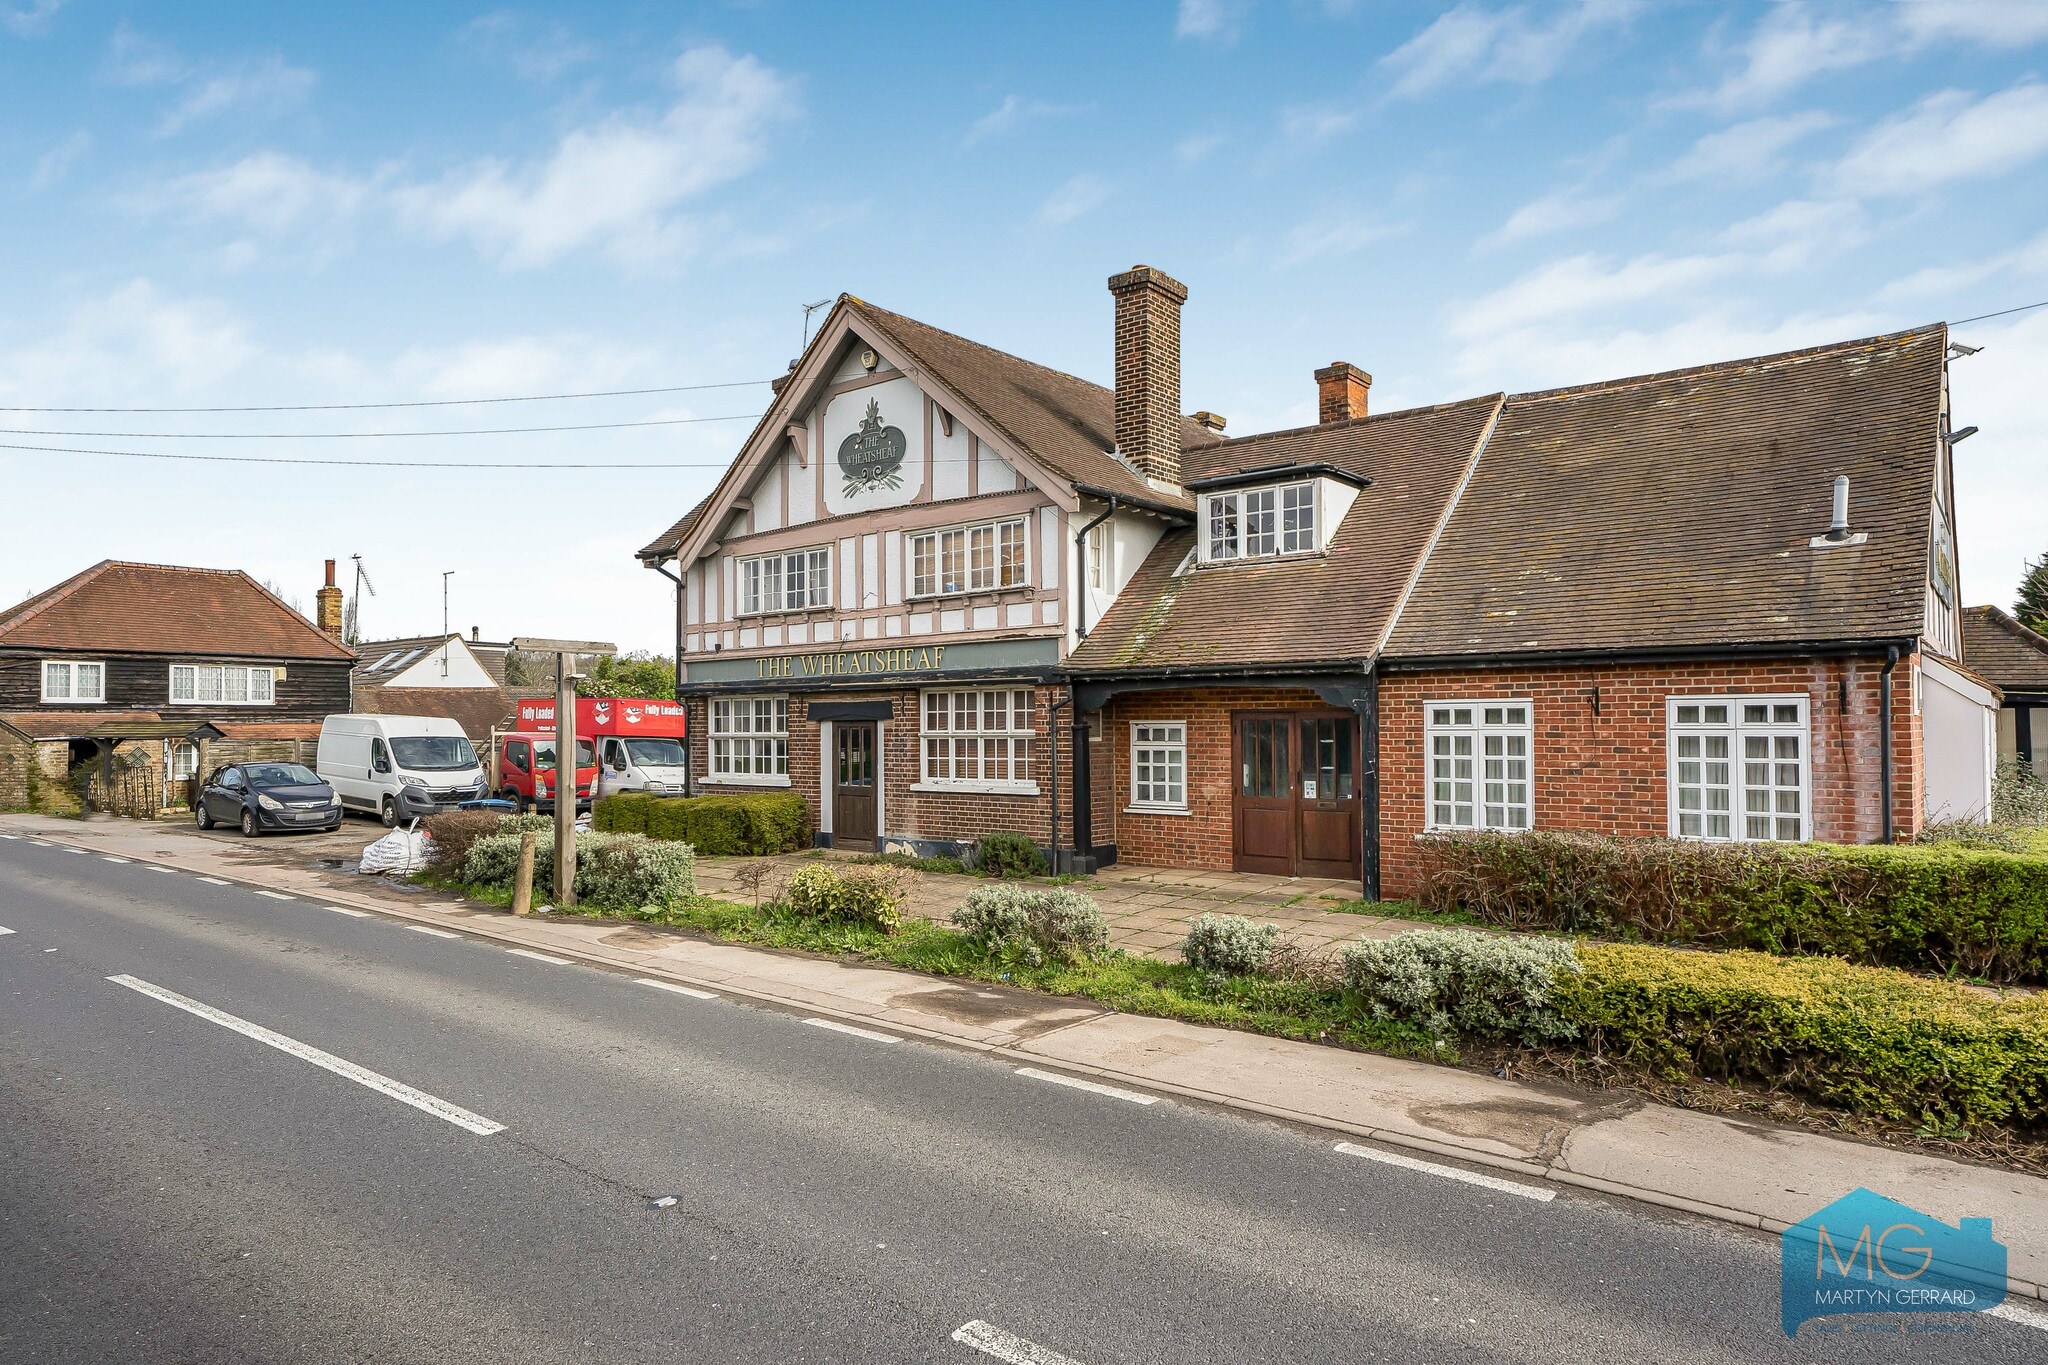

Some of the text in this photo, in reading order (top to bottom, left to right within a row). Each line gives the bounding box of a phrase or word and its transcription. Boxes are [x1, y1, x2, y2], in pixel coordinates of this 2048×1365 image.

[864, 435, 880, 449] THE
[846, 445, 898, 466] WHEATSHEAF
[756, 646, 945, 678] THE WHEATSHEAF
[522, 706, 555, 721] Fully Loaded
[645, 704, 683, 716] Fully Loaded
